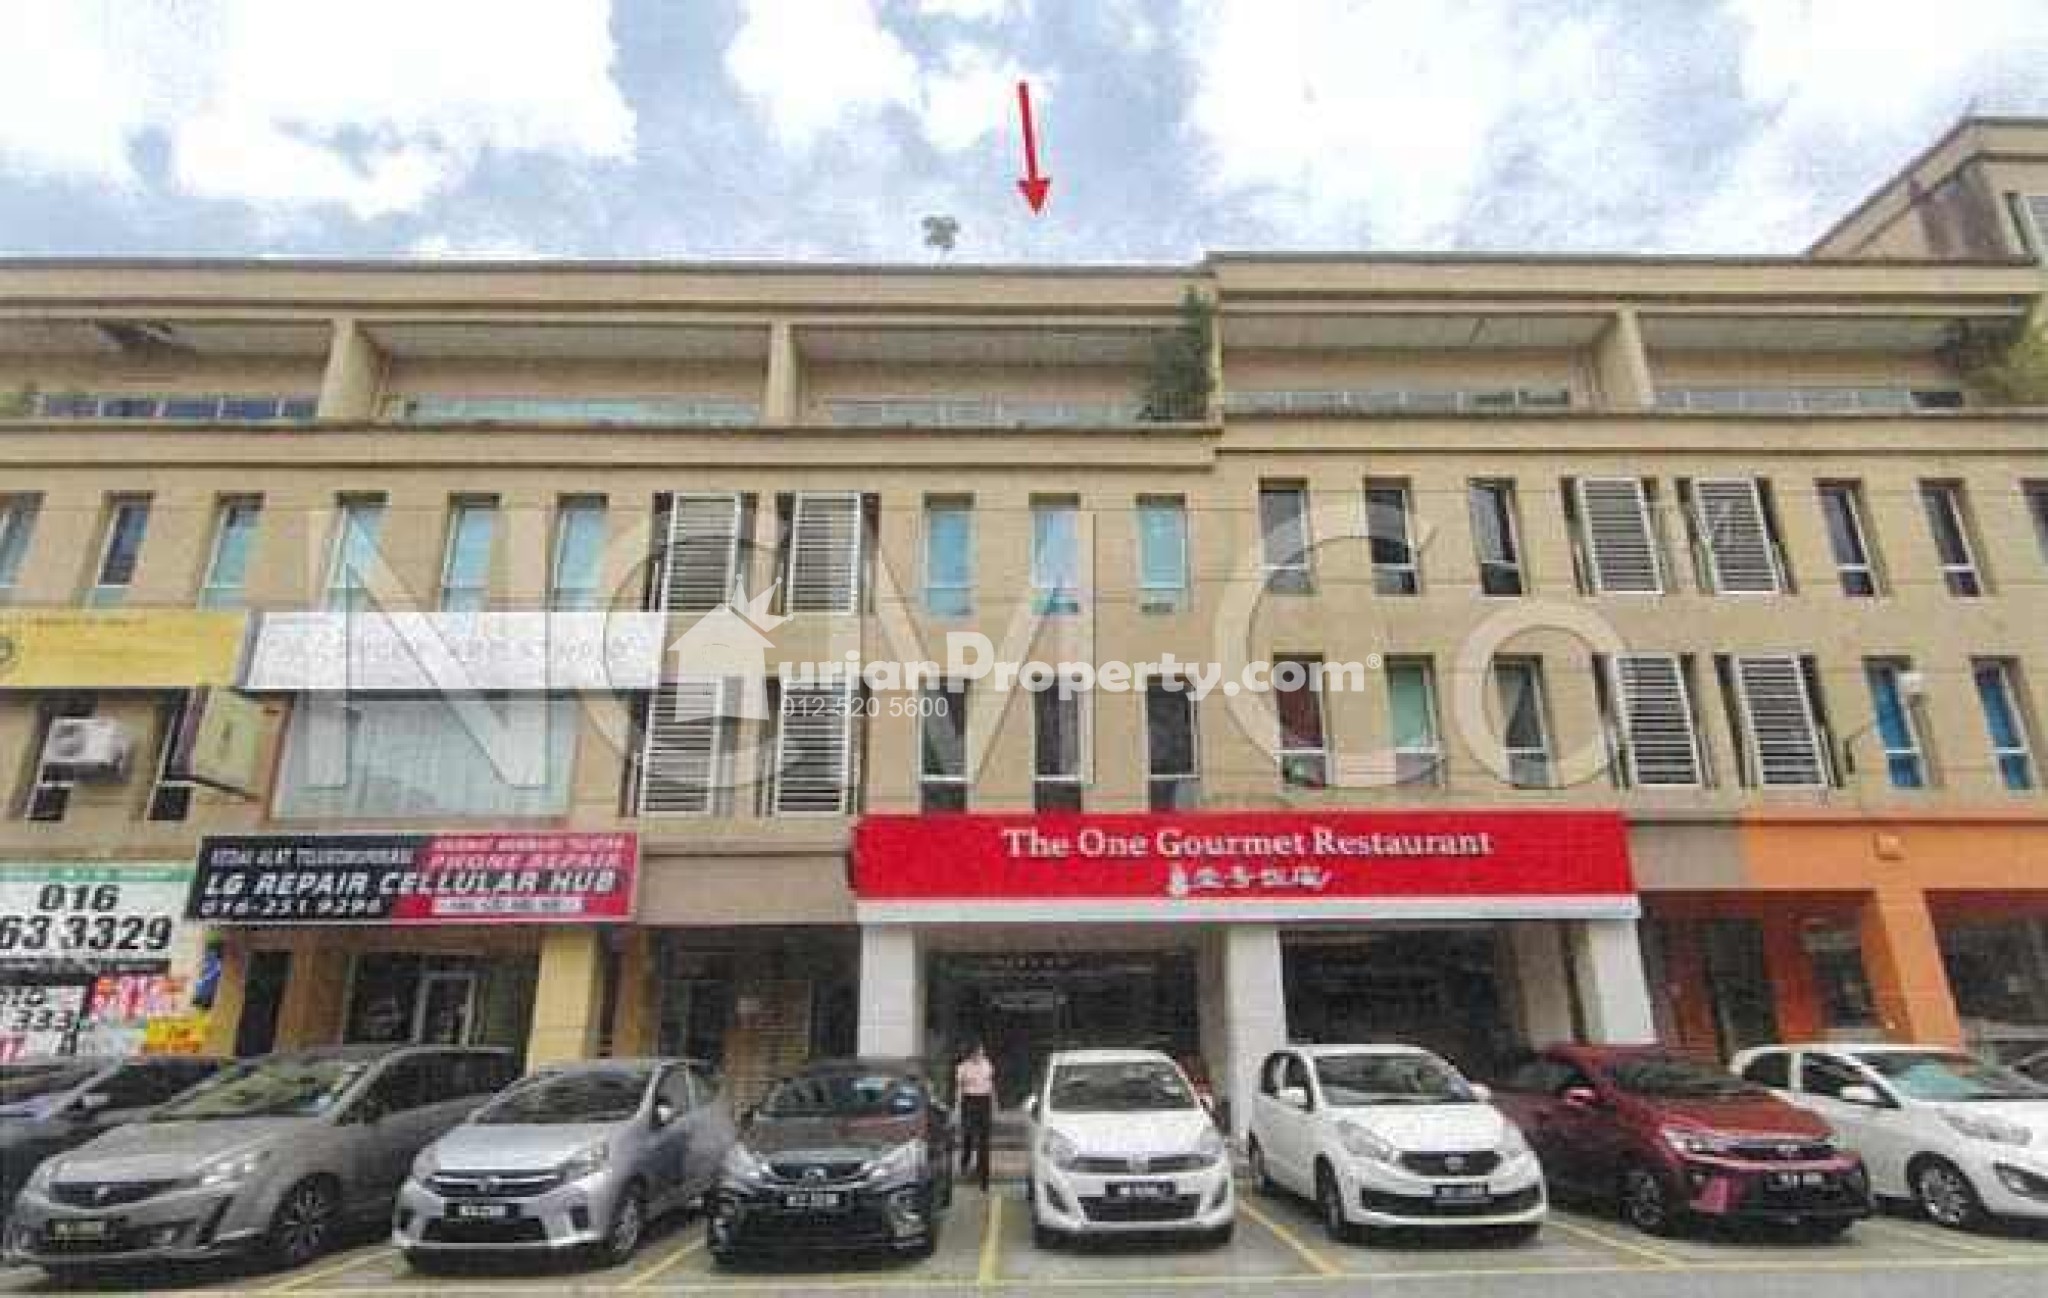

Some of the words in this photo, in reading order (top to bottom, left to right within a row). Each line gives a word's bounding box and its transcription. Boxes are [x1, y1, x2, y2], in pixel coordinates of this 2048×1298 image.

[1003, 827, 1069, 858] The
[1079, 828, 1149, 857] One
[1156, 828, 1306, 856] Gourmet
[1312, 826, 1495, 856] Restaurant
[205, 872, 246, 896] LG
[253, 872, 369, 896] REPAIR
[379, 870, 538, 896] CELLULAR
[549, 869, 616, 892] HUB
[38, 883, 120, 912] 016
